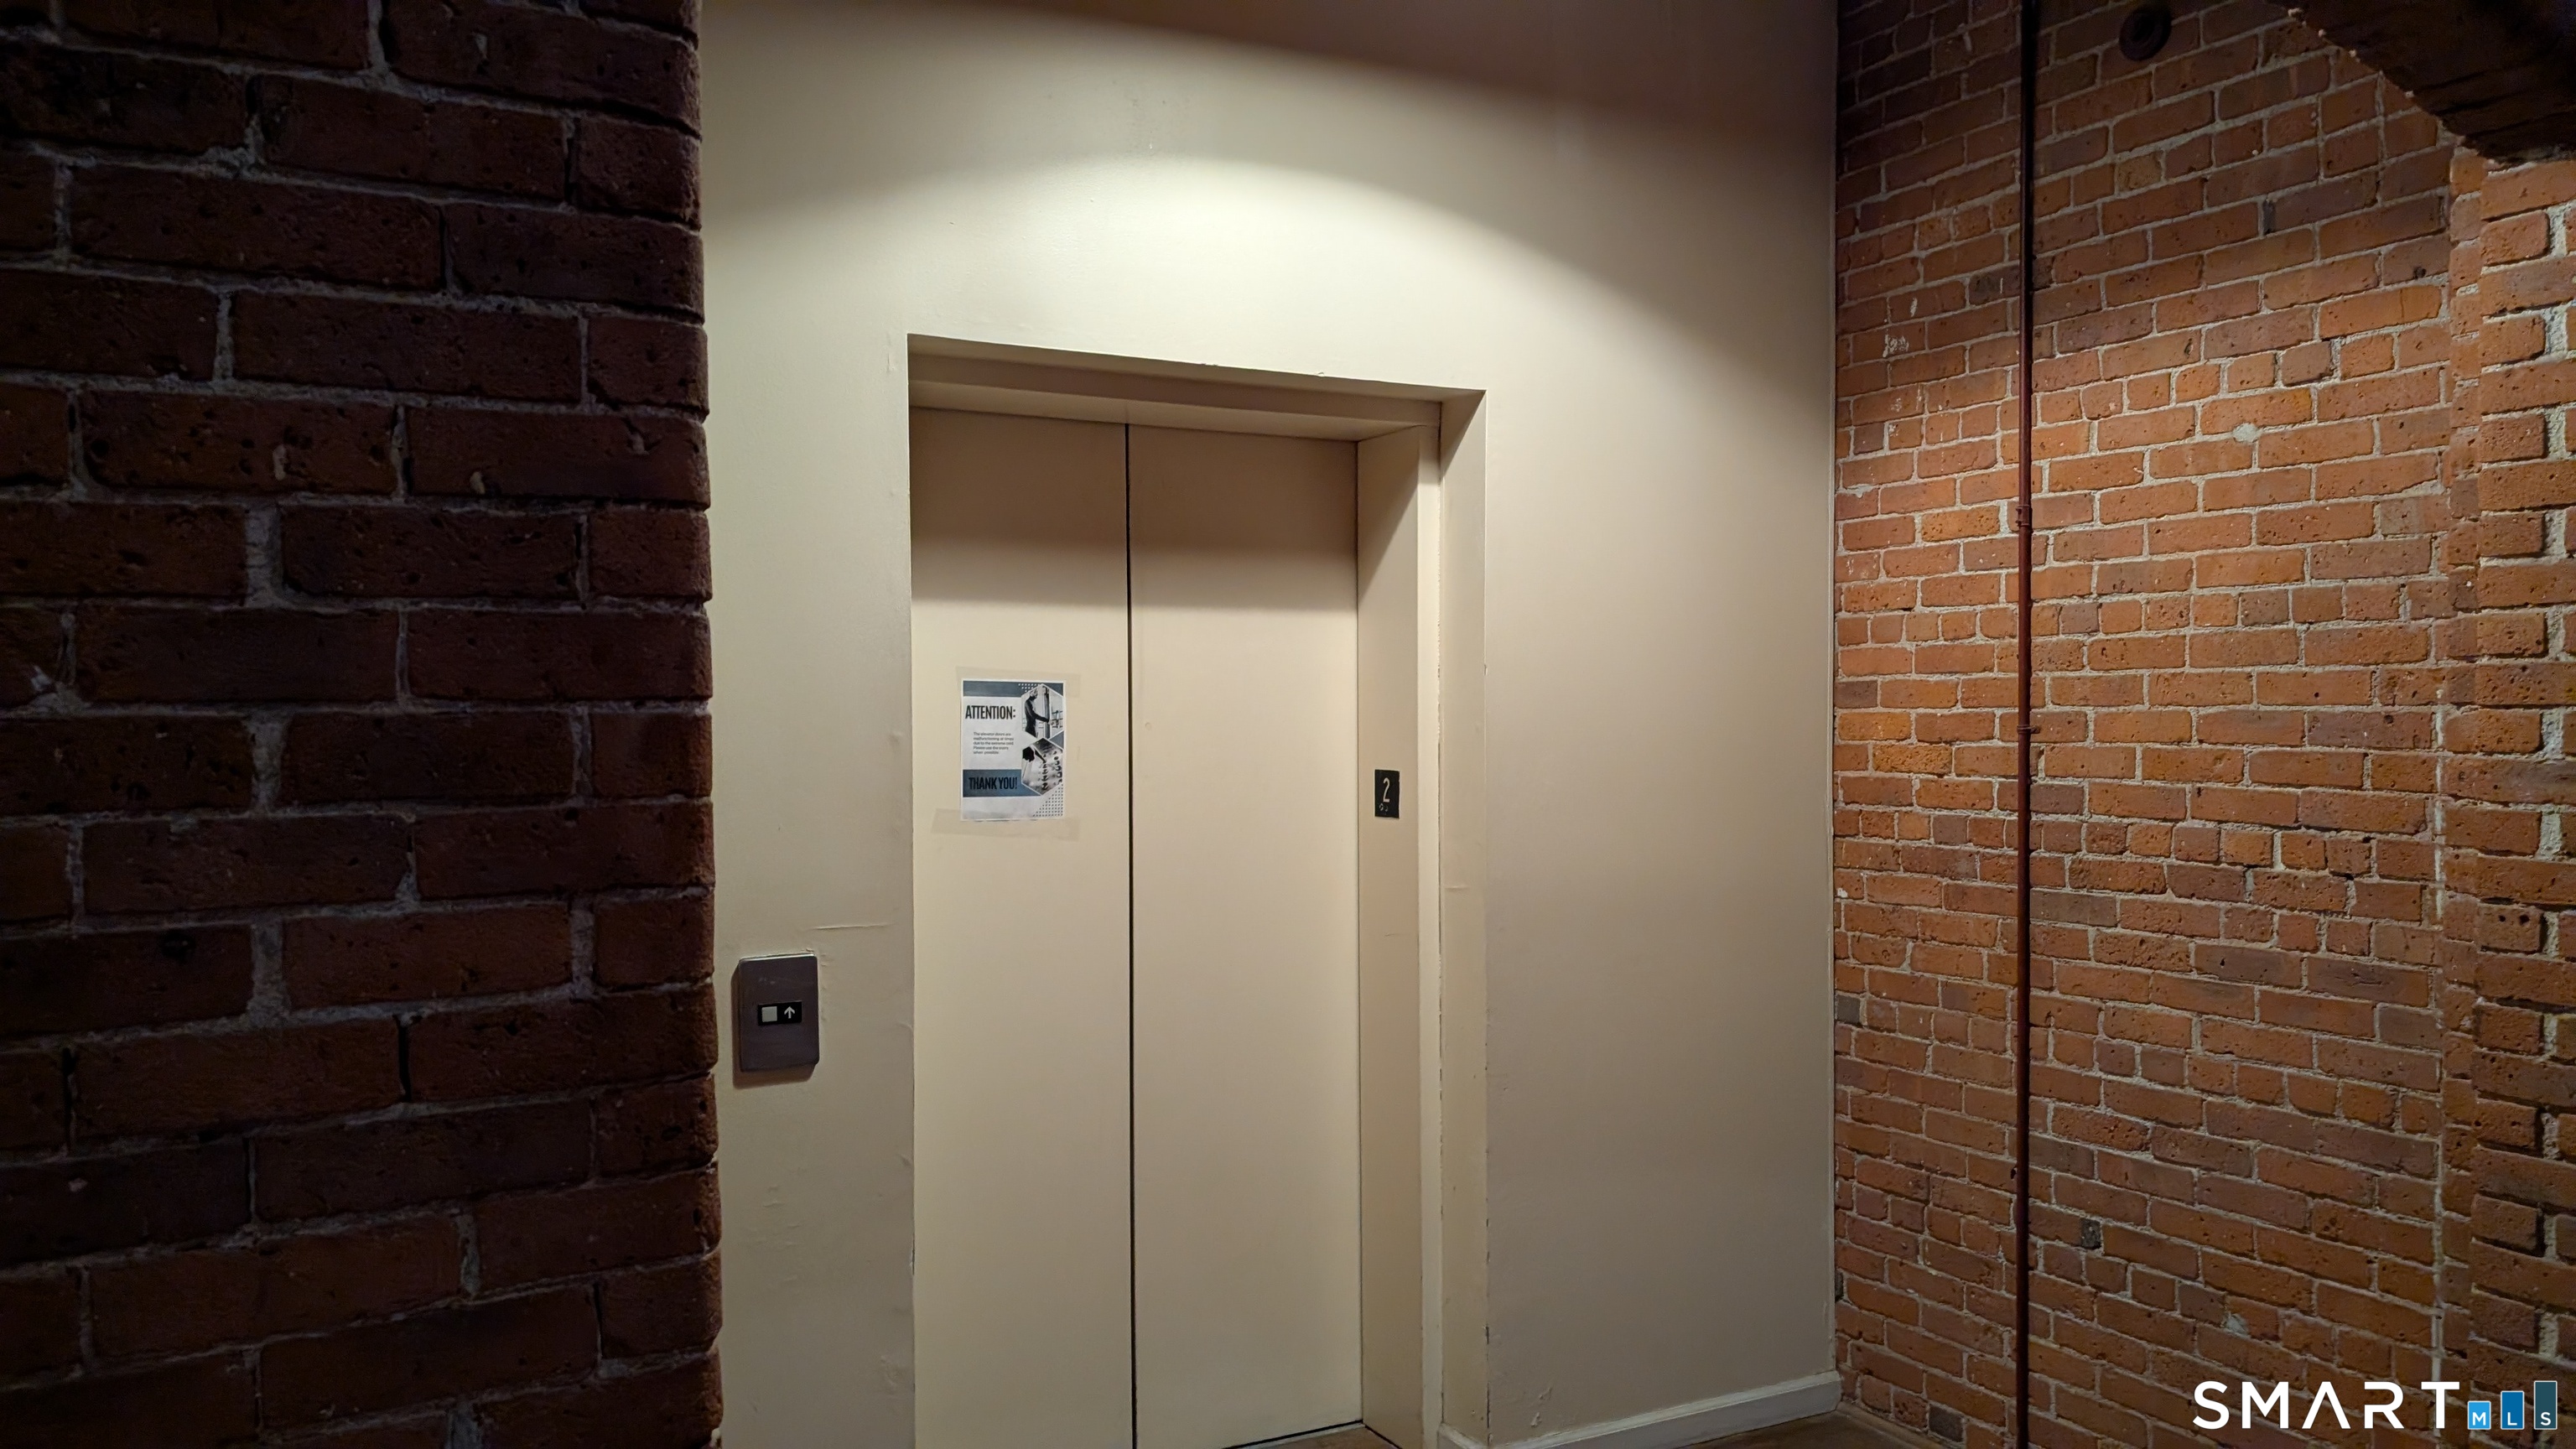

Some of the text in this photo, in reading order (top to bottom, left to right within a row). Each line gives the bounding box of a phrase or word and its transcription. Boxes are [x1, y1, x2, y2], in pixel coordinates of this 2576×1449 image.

[965, 705, 1016, 719] ATTENTION:
[969, 776, 1018, 791] THANK YOU!
[1383, 776, 1390, 802] 2
